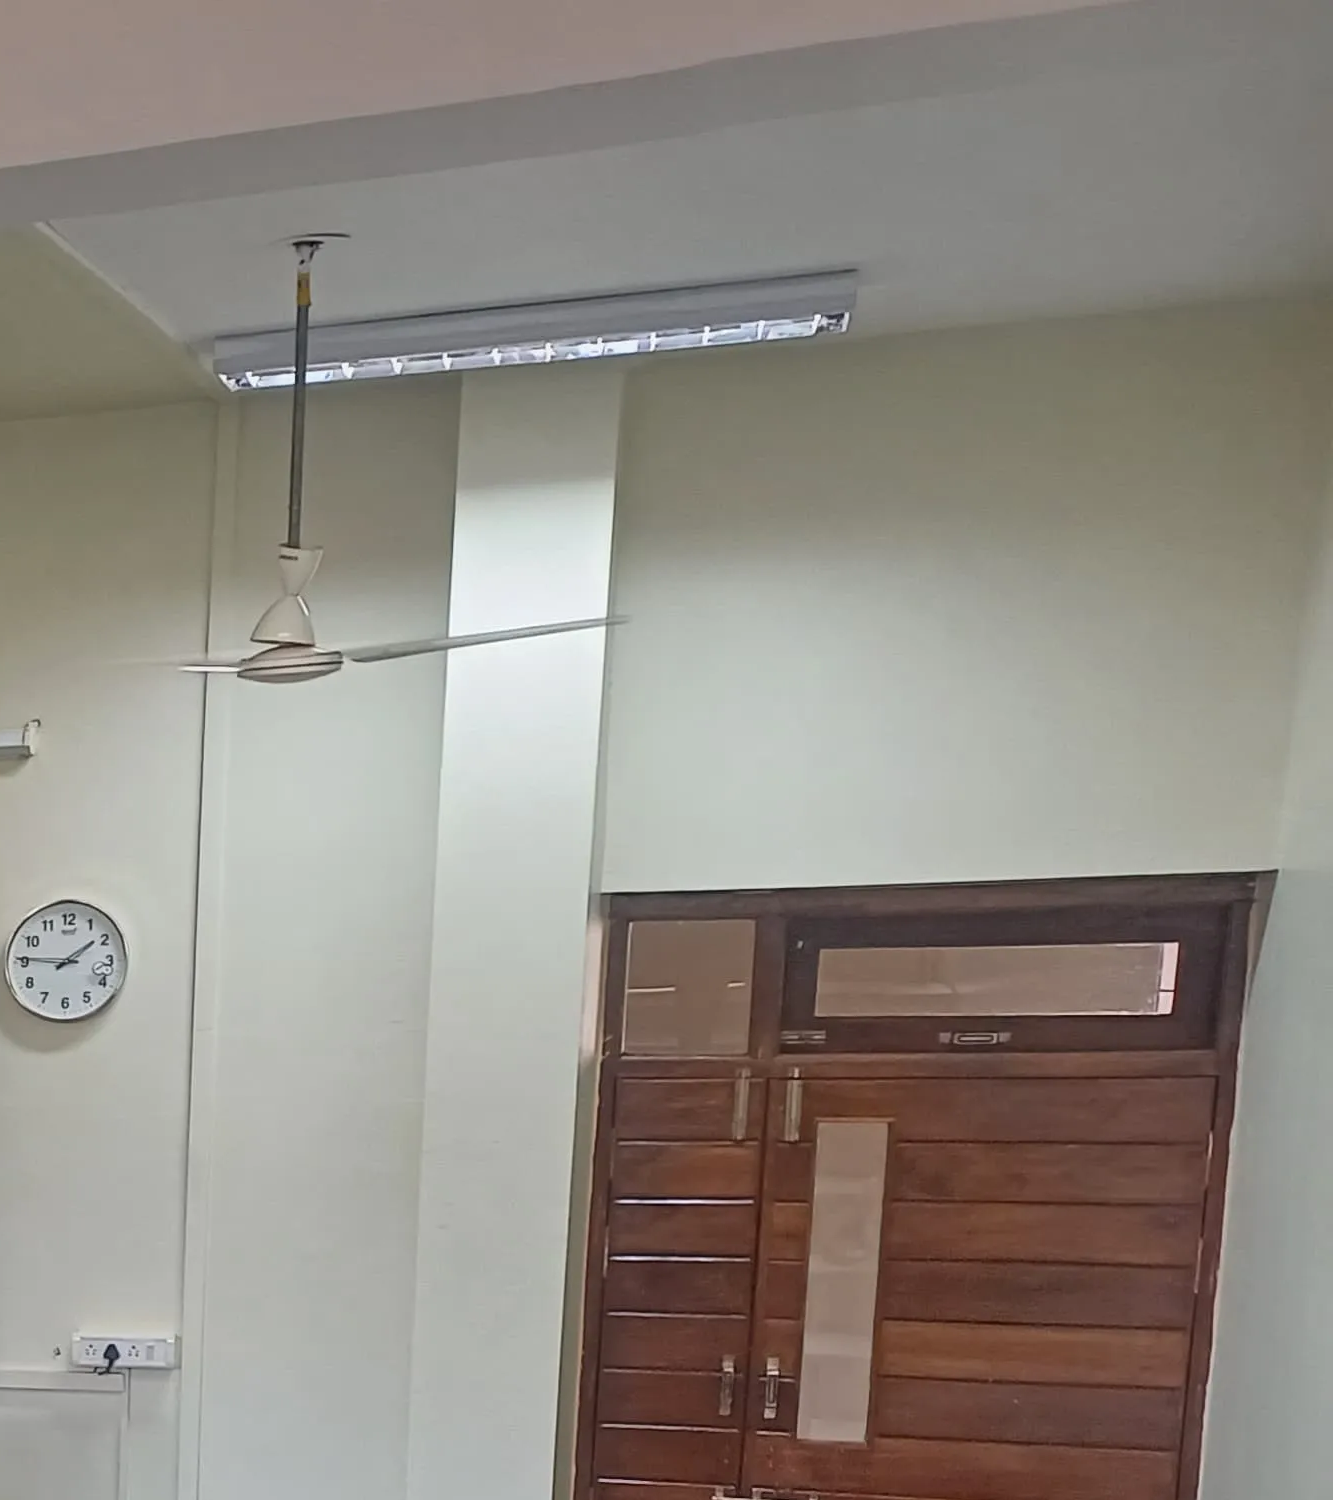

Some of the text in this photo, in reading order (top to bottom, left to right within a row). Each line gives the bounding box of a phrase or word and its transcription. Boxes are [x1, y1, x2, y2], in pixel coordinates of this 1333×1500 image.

[42, 919, 54, 931] 11
[61, 913, 76, 925] 12
[87, 918, 93, 931] 1
[25, 935, 39, 947] 10
[100, 933, 110, 946] 2
[20, 956, 29, 968] 9
[105, 954, 114, 966] 3
[25, 976, 34, 989] 8
[98, 975, 107, 988] 4
[40, 991, 49, 1004] 7
[61, 997, 70, 1009] 6
[82, 991, 91, 1004] 5
